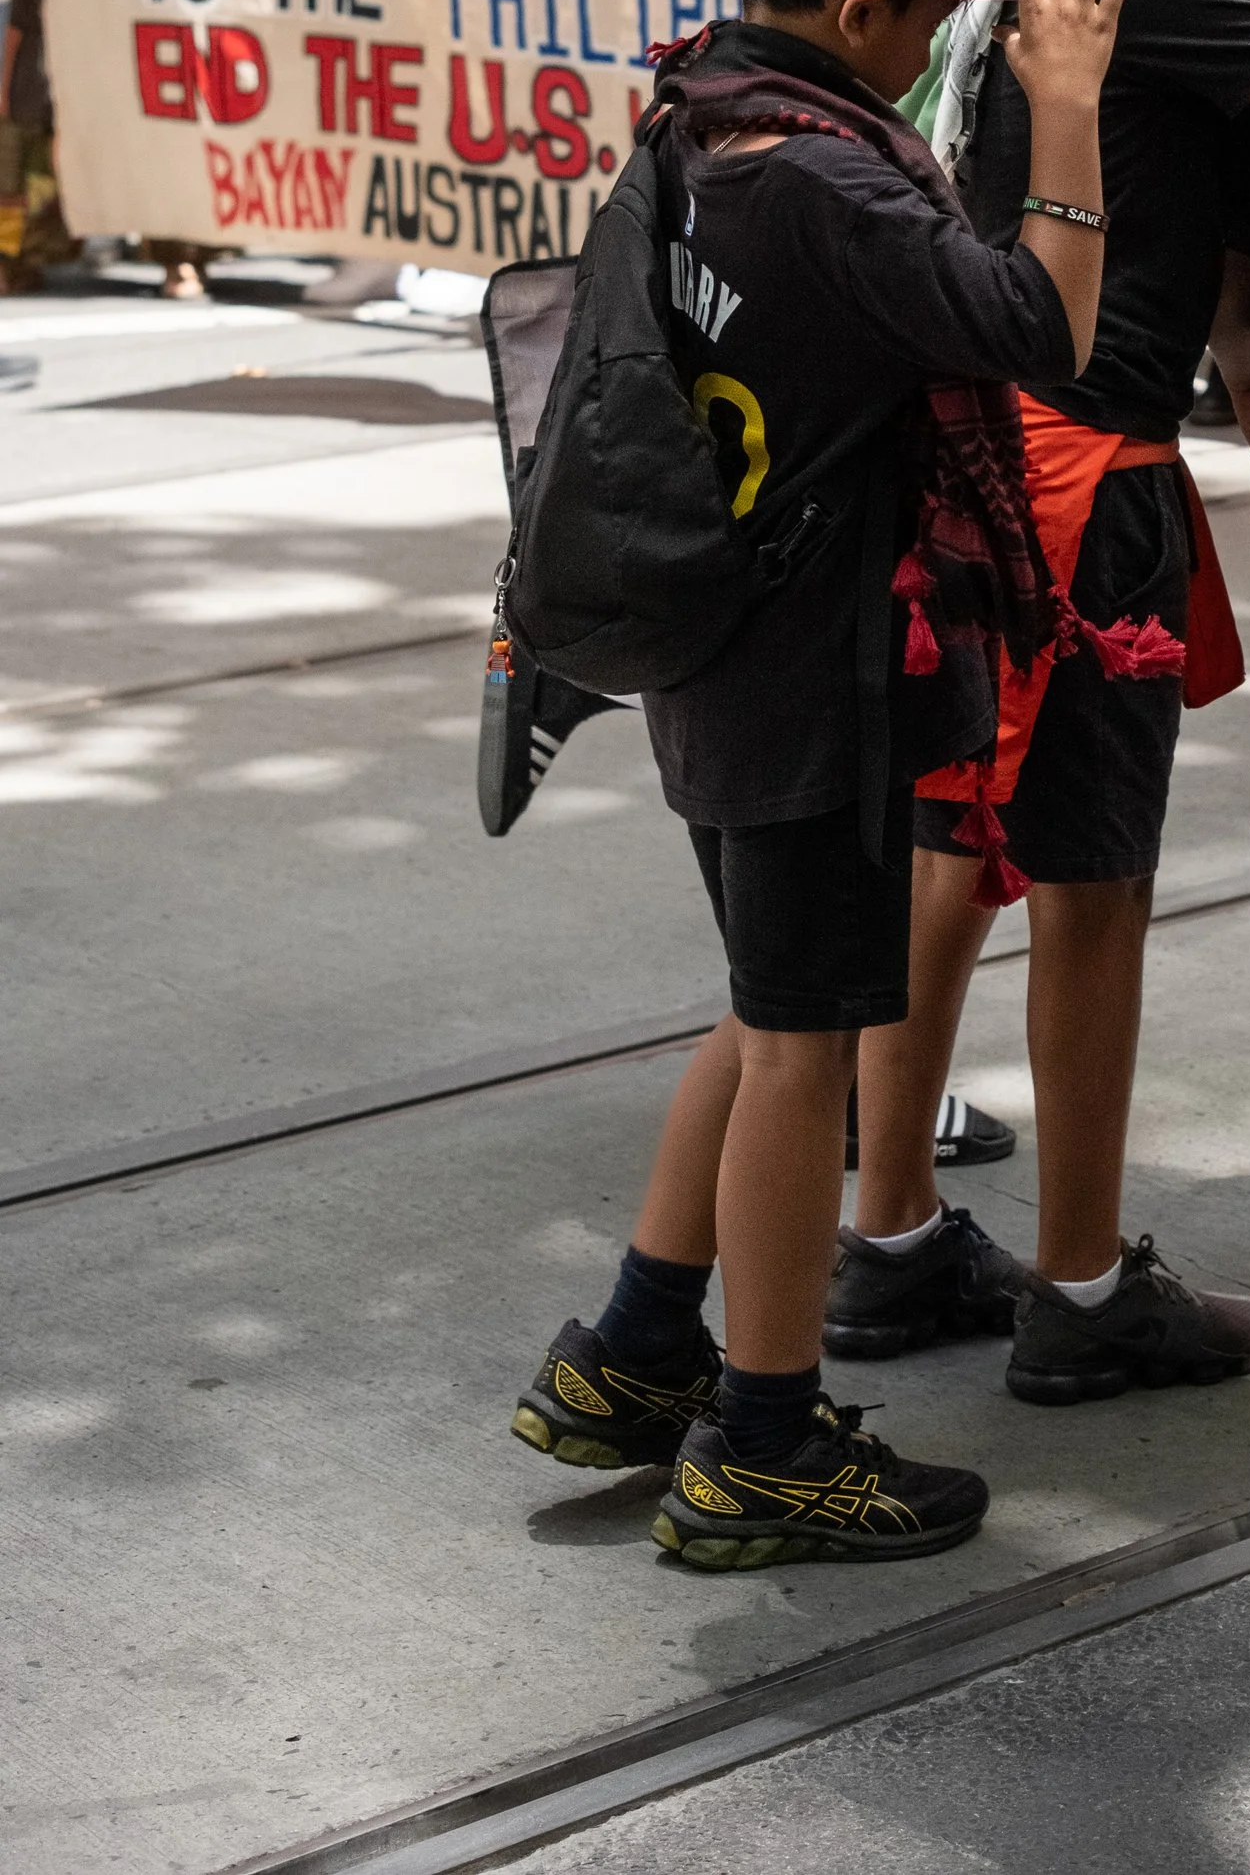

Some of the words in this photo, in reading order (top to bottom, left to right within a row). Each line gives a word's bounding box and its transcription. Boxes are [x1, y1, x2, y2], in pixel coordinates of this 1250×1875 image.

[134, 21, 271, 126] END
[304, 35, 424, 144] THE
[447, 53, 617, 182] U.S.
[204, 138, 358, 232] BAYAN
[1067, 207, 1102, 227] SAVE
